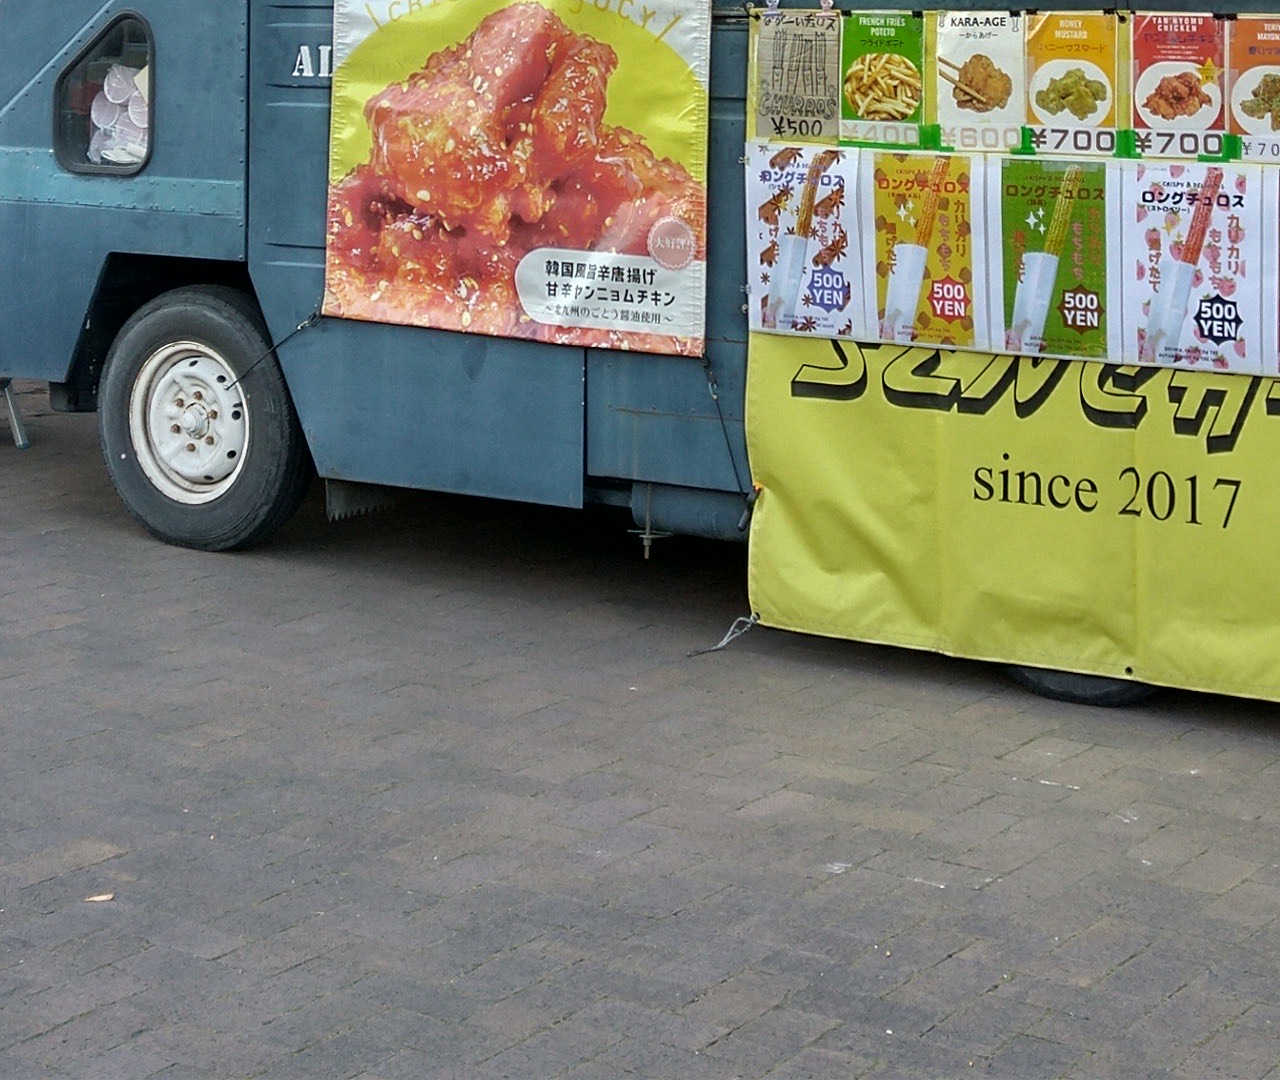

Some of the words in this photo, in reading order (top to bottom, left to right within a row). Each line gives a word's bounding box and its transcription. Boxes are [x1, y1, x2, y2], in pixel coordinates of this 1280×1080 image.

[859, 18, 884, 26] FRENCH
[886, 18, 906, 26] FRIES
[950, 17, 1006, 27] KARA-AGE
[1157, 24, 1197, 32] CHICKEN
[870, 28, 895, 37] POTETO
[1055, 30, 1088, 39] MUSTARD
[1040, 44, 1106, 53] ハニーマスタード
[759, 92, 837, 120] CHURROS
[771, 117, 822, 138] ¥500
[1031, 128, 1115, 152] ¥700
[1135, 133, 1223, 155] ¥700
[877, 177, 969, 194] ロングチュロス
[1006, 185, 1105, 201] ロングチュロス
[1142, 191, 1245, 208] ロングチュロス
[545, 260, 657, 286] 韓国風旨辛唐揚げ
[813, 273, 842, 289] 500
[545, 282, 676, 307] 甘辛ヤンニョムチキン
[812, 290, 843, 306] YEN
[933, 283, 965, 300] 500
[933, 300, 965, 317] YEN
[1064, 293, 1098, 309] 500
[1063, 310, 1099, 327] YEN
[1201, 303, 1236, 319] 500
[1200, 321, 1236, 338] YEN
[972, 453, 1099, 514] since
[1117, 467, 1243, 529] 2017
